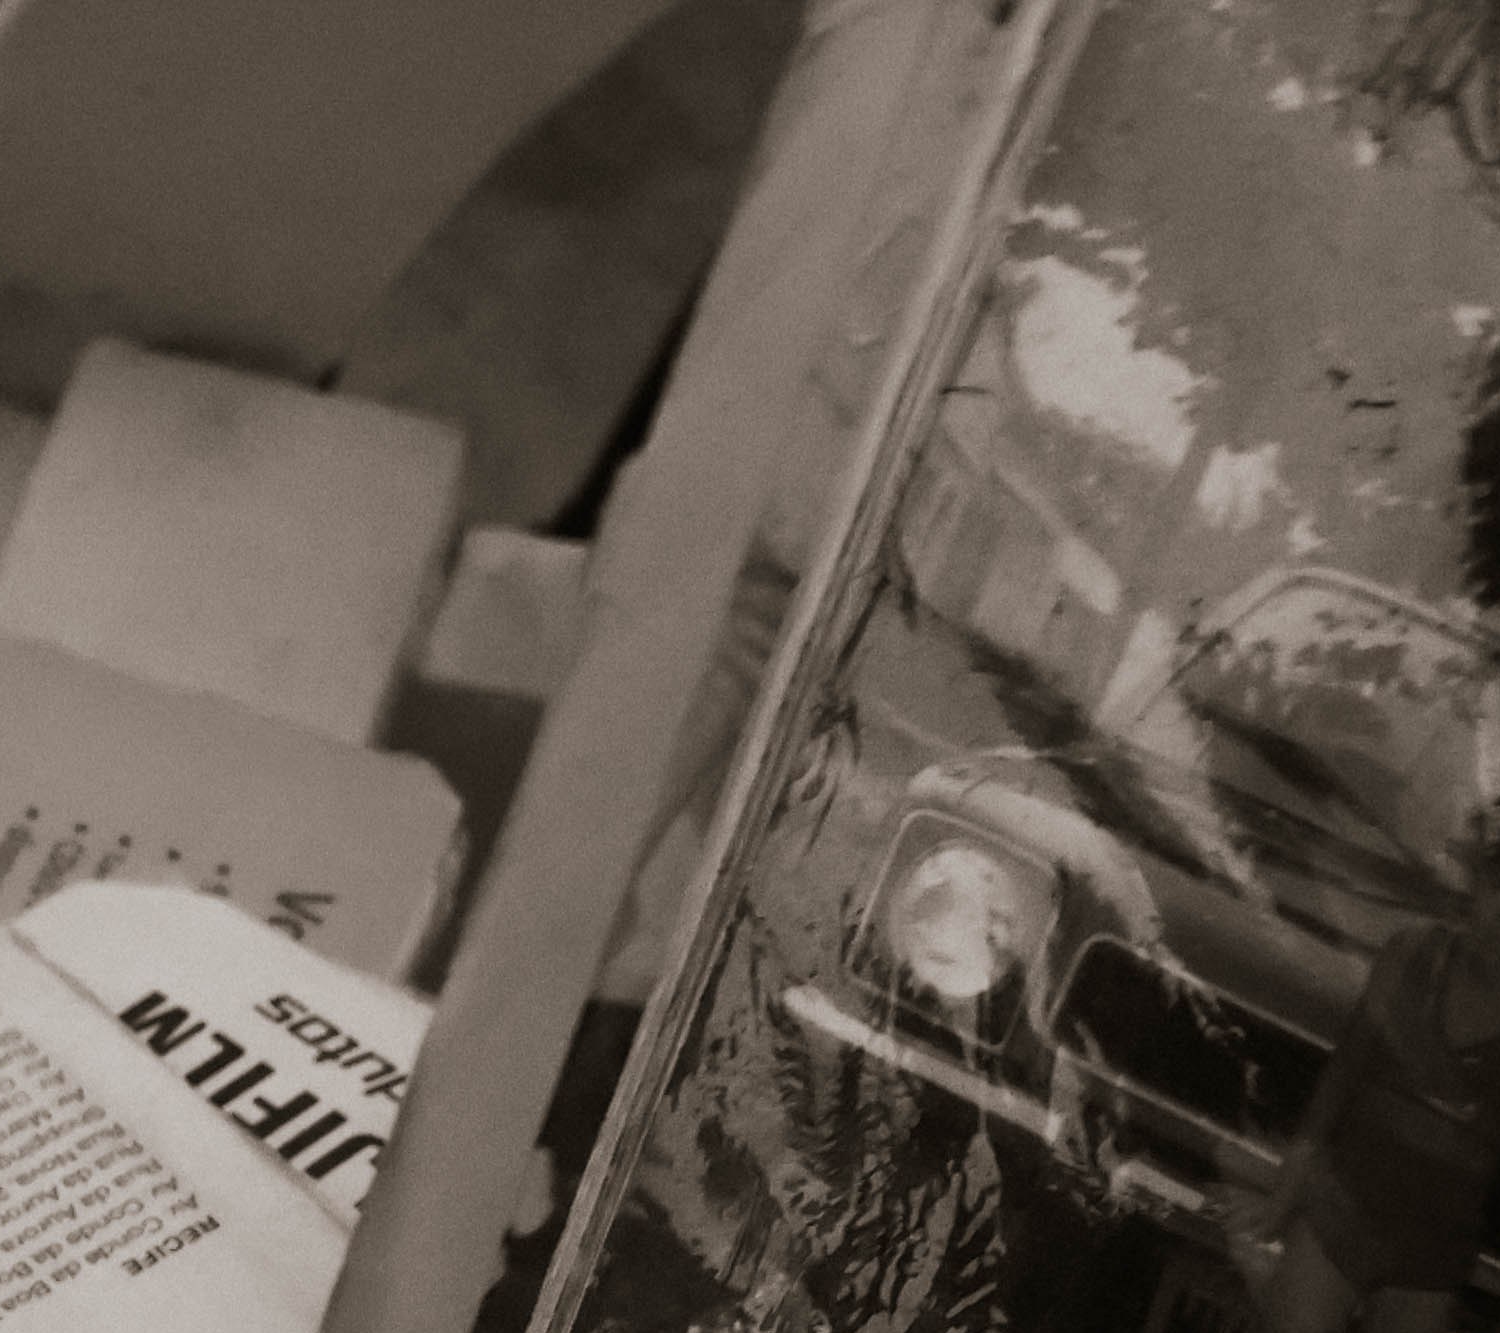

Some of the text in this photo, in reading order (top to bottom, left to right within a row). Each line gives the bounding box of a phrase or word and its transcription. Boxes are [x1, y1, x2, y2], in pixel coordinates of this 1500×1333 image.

[61, 1167, 92, 1187] da
[113, 1157, 163, 1187] Rua
[79, 1186, 110, 1207] da
[31, 1244, 62, 1264] da
[122, 1215, 220, 1275] RECIFE
[50, 1260, 80, 1282] da
[0, 1279, 51, 1311] Boa
